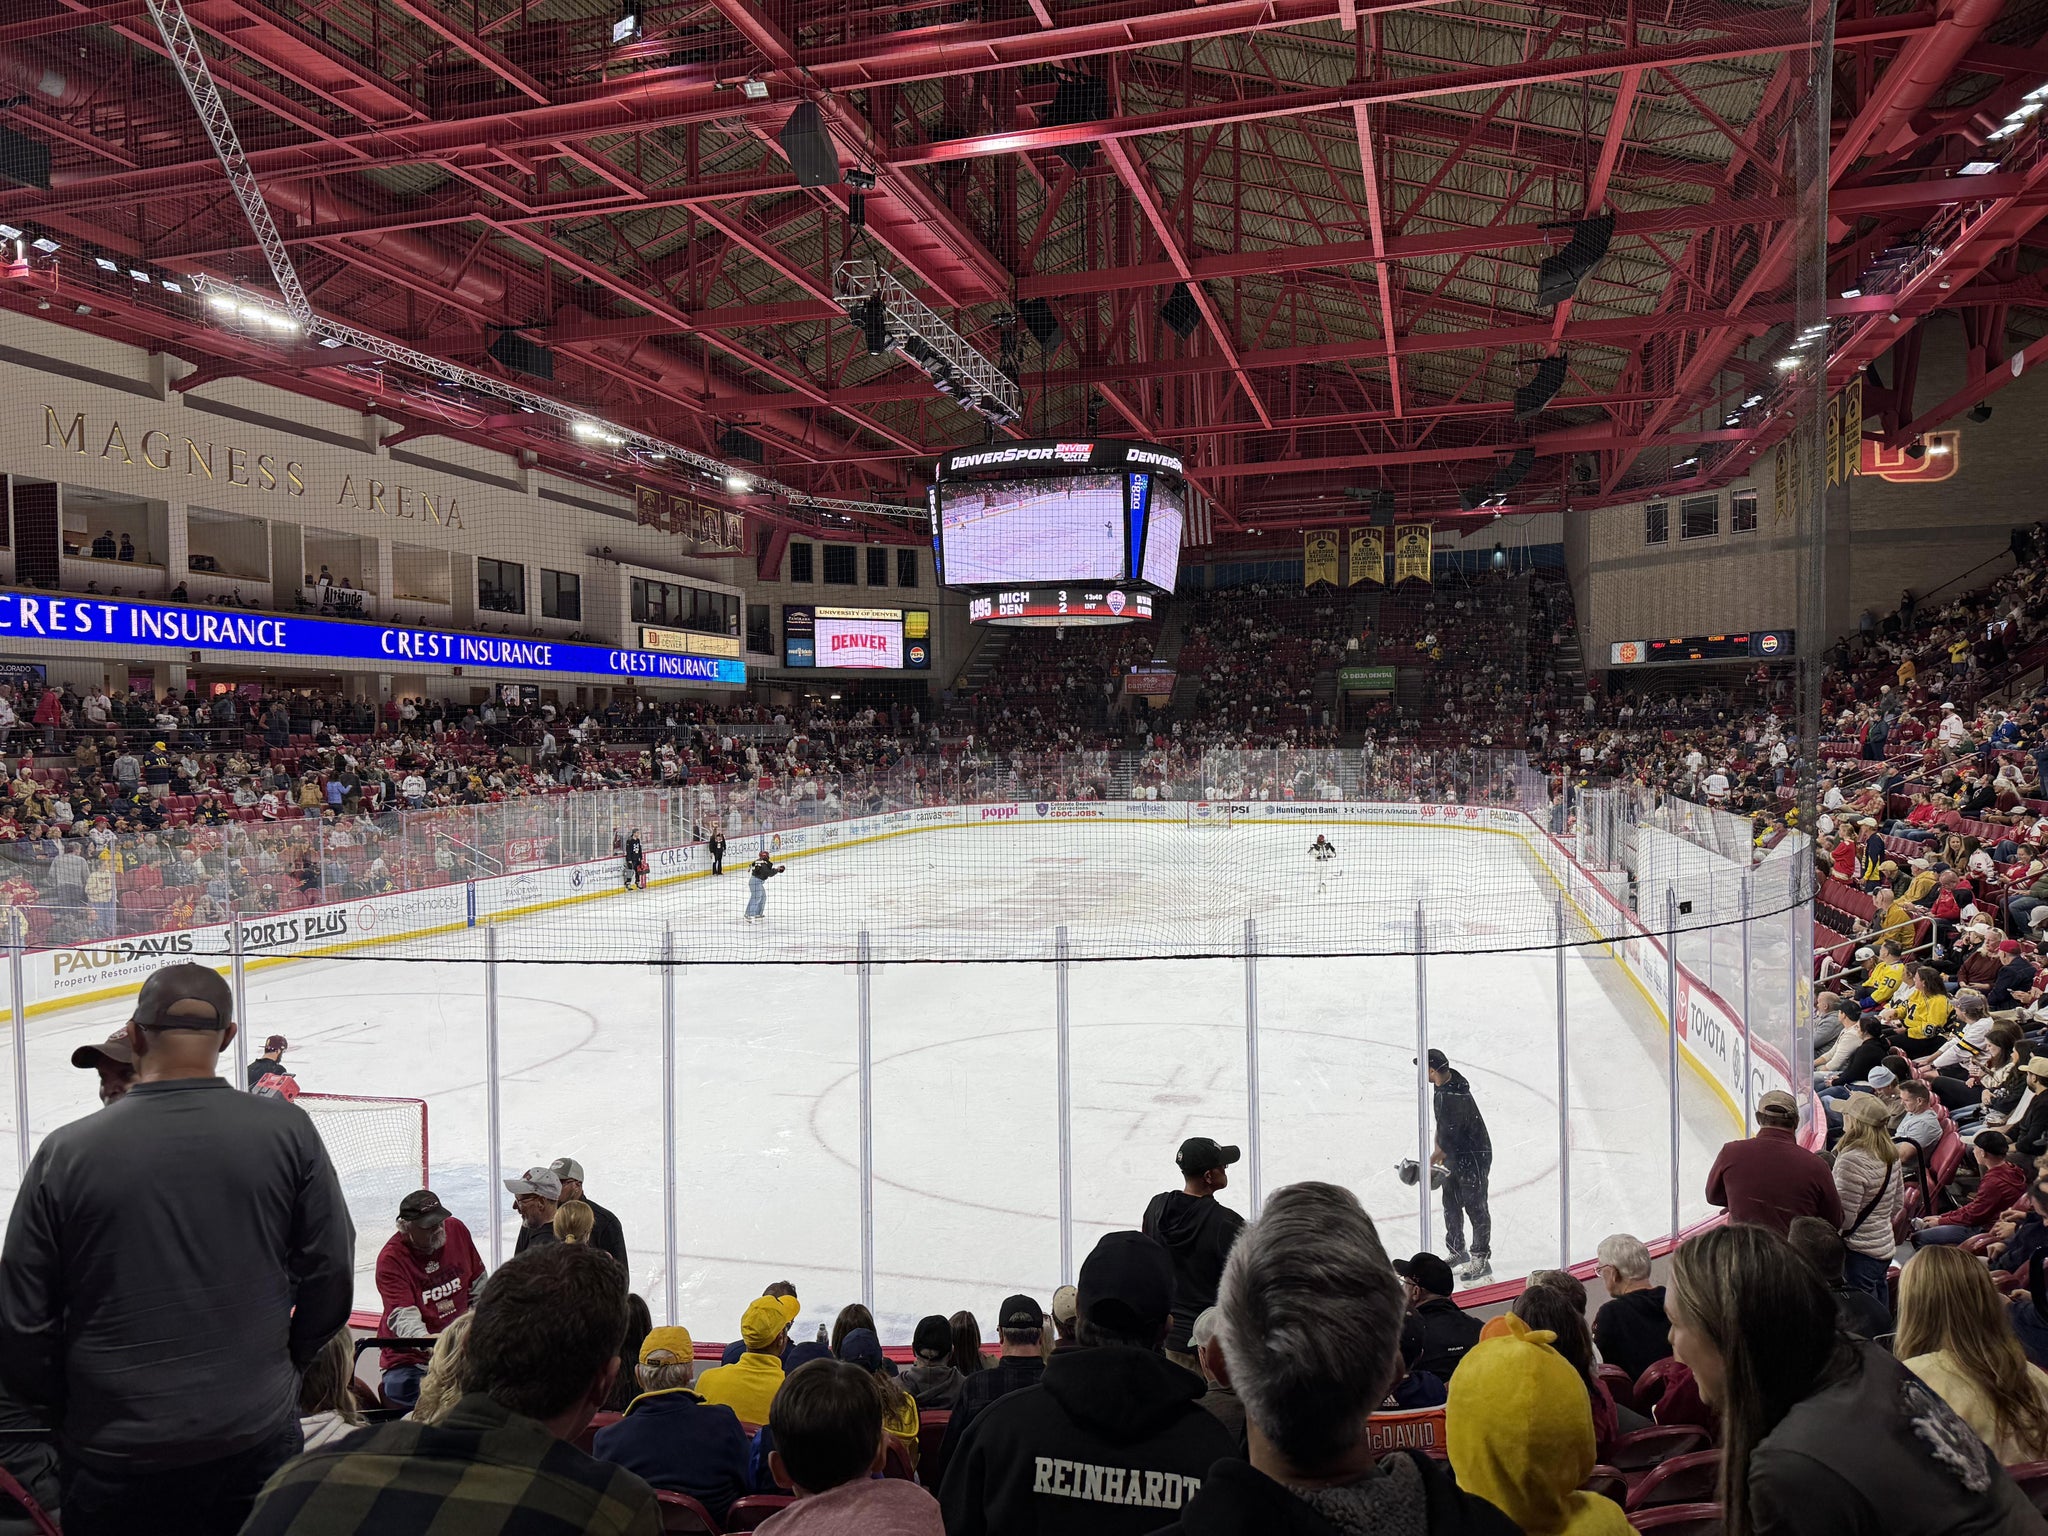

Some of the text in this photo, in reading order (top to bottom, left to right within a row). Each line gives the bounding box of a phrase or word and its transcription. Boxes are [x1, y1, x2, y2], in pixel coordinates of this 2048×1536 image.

[40, 403, 465, 530] MAGNESS ARENA
[1131, 474, 1144, 510] cigna
[322, 587, 363, 607] Altitude
[999, 592, 1029, 604] MICH
[1059, 591, 1067, 601] 3
[999, 605, 1023, 616] DEN
[1059, 602, 1067, 613] 2
[131, 609, 286, 647] INSURANCE
[381, 630, 552, 665] CREST INSURANCE
[831, 633, 887, 652] DENVER
[610, 651, 719, 678] CREST INSURANCE
[916, 811, 942, 821] canvas
[981, 803, 1019, 819] poppi
[1216, 805, 1250, 814] PEPSI
[1276, 806, 1338, 815] Huntington Bank
[660, 846, 696, 866] CREST
[728, 842, 760, 856] COLORADO
[224, 919, 299, 946] SPORTS
[54, 973, 98, 989] Property
[101, 963, 157, 980] Restoration
[1882, 976, 1897, 989] 30
[1690, 1002, 1726, 1062] TOYOTA
[421, 1278, 462, 1305] FOUR
[1032, 1456, 1202, 1510] REINHARDT
